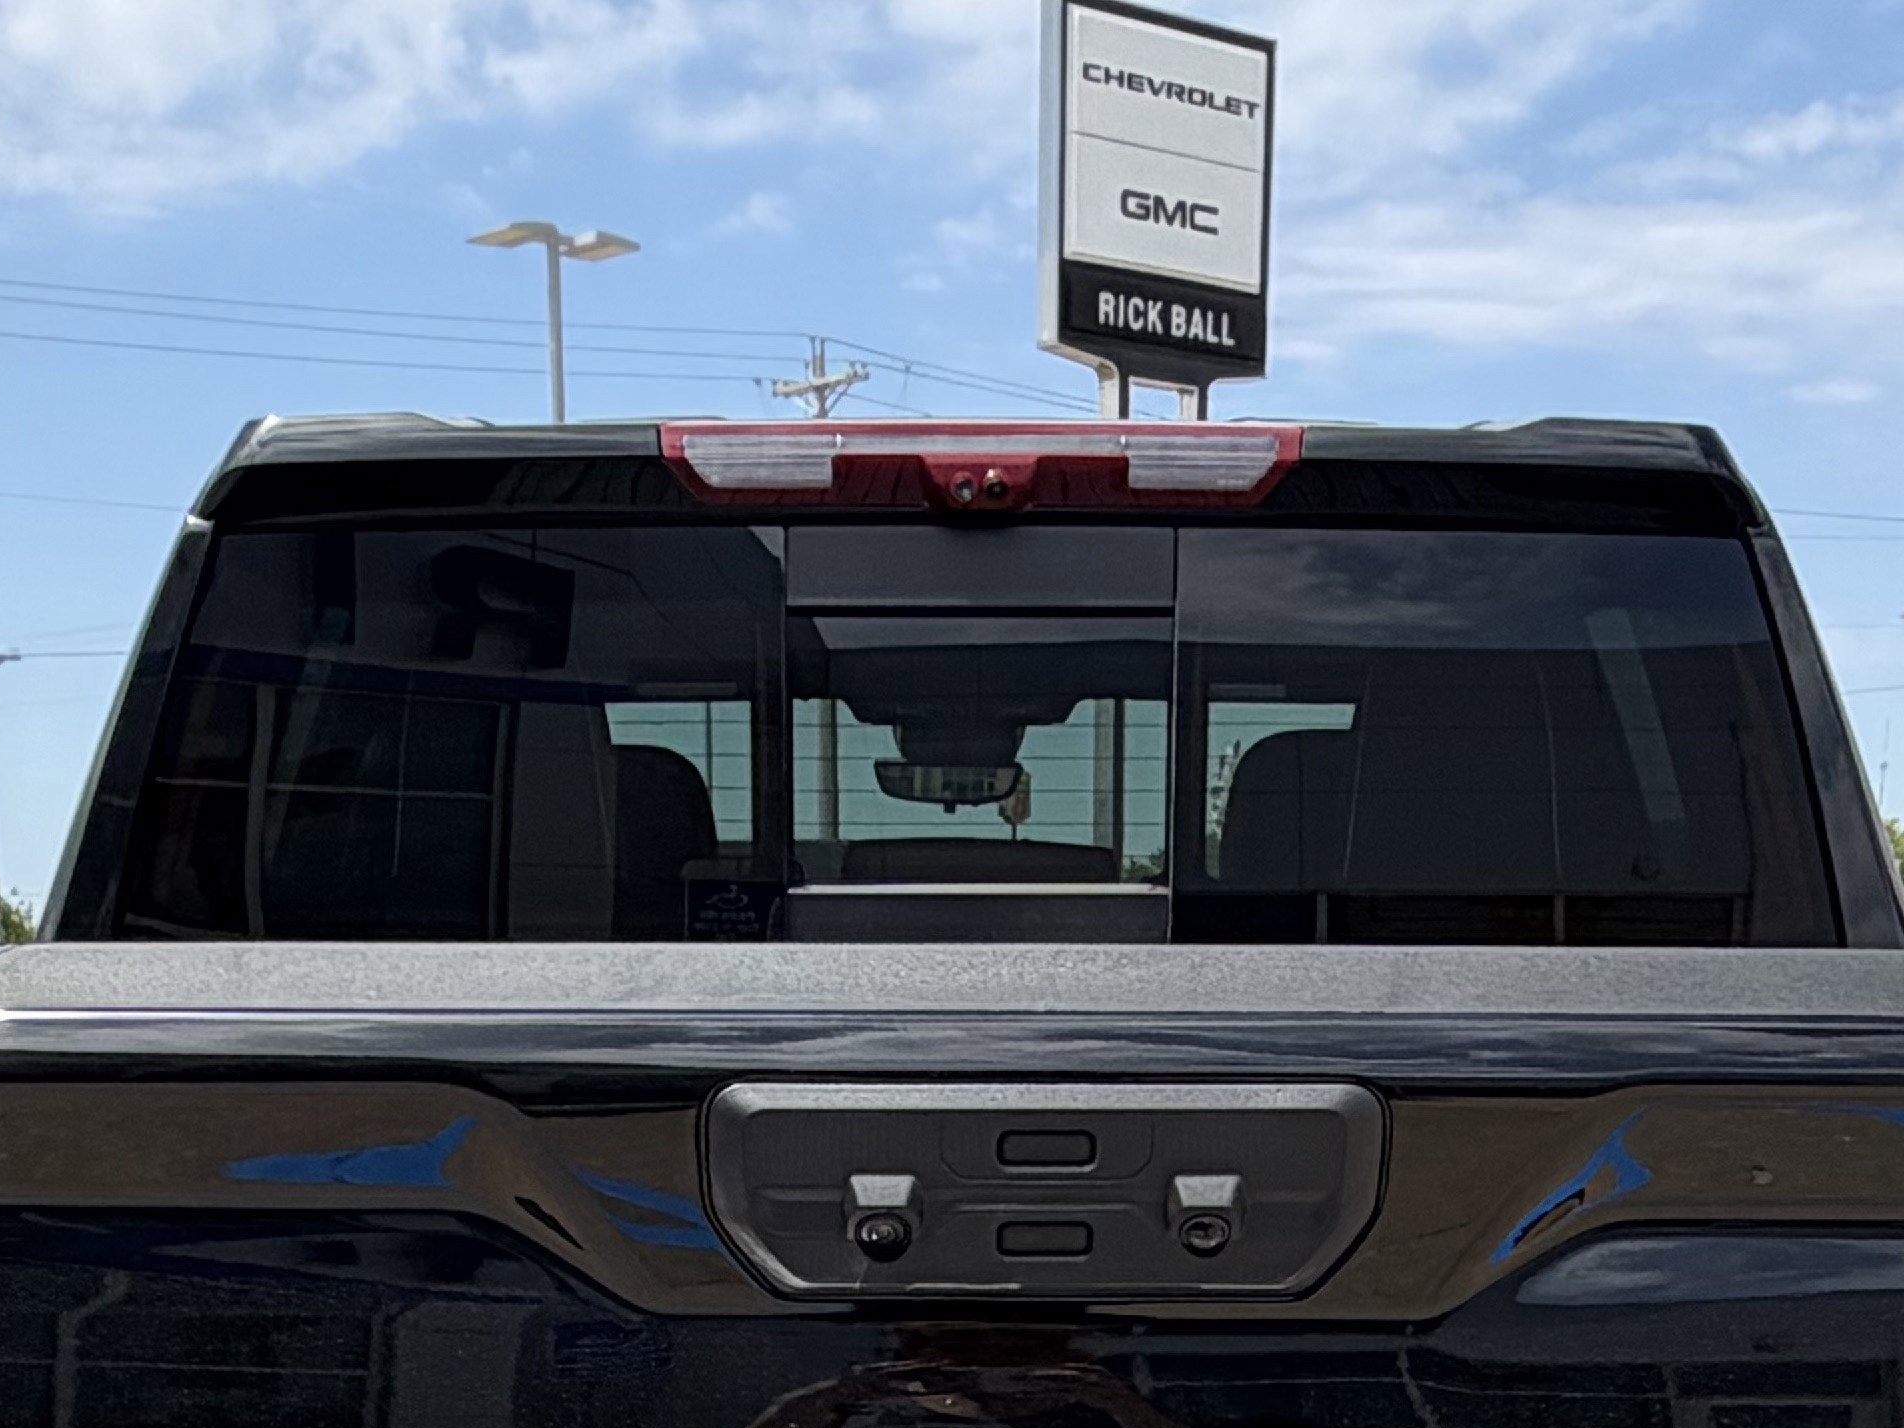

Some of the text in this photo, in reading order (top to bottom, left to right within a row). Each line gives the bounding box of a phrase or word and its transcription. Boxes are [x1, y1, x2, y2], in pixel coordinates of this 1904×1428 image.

[1082, 61, 1260, 119] CHEVROLET
[1120, 188, 1220, 236] GMC
[1098, 291, 1235, 346] RICK BALL
